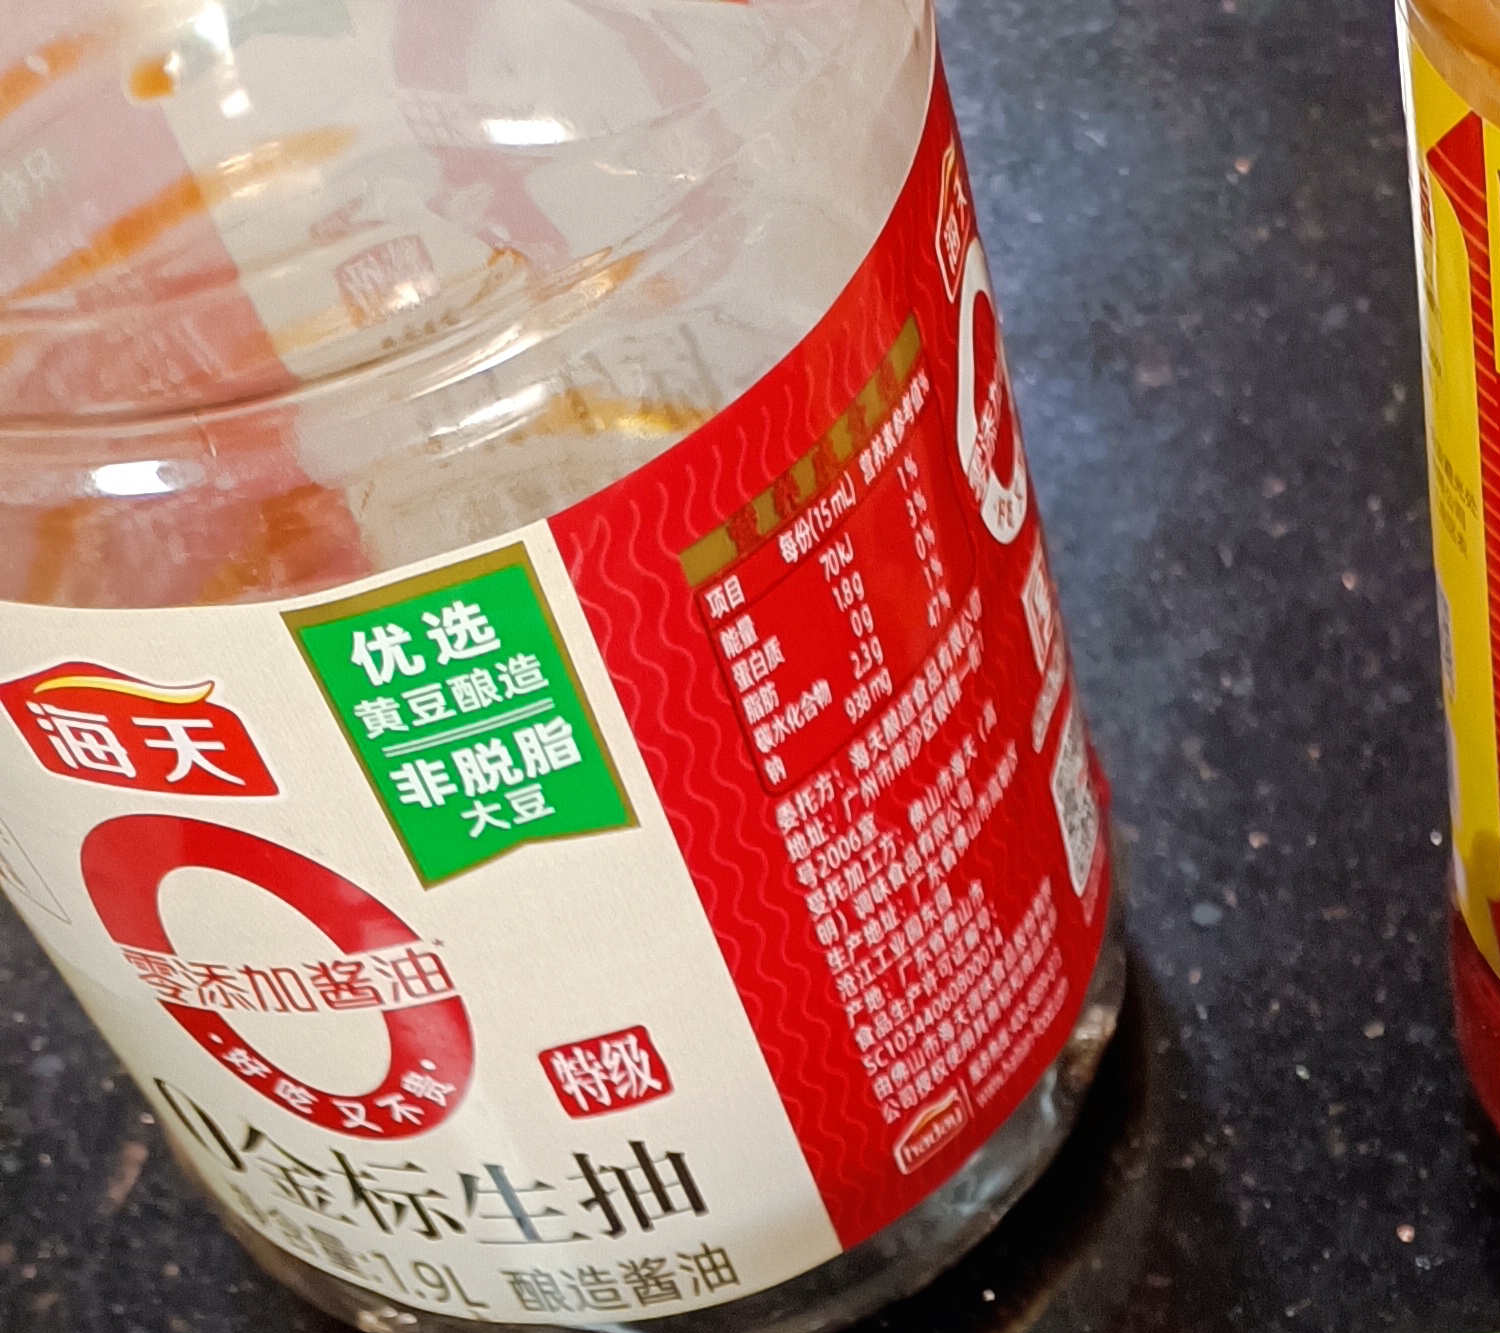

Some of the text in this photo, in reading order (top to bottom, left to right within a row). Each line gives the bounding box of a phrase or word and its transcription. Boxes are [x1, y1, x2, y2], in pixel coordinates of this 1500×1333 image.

[704, 574, 745, 619] 项目
[350, 599, 503, 687] 优选
[719, 614, 760, 661] 能量
[731, 635, 785, 693] 蛋白质
[353, 652, 551, 742] 黄豆酿造
[742, 680, 780, 725] 脂肪
[752, 677, 833, 754] 碳水化合物
[27, 701, 246, 788] 海天
[388, 716, 583, 812] 非脱脂
[763, 755, 787, 786] 钠
[460, 783, 556, 839] 大豆
[121, 941, 457, 1013] 零添加酱油
[222, 1046, 457, 1135] 好吃又不贵
[552, 1032, 665, 1112] 特级
[501, 1240, 742, 1316] 酿造酱油
